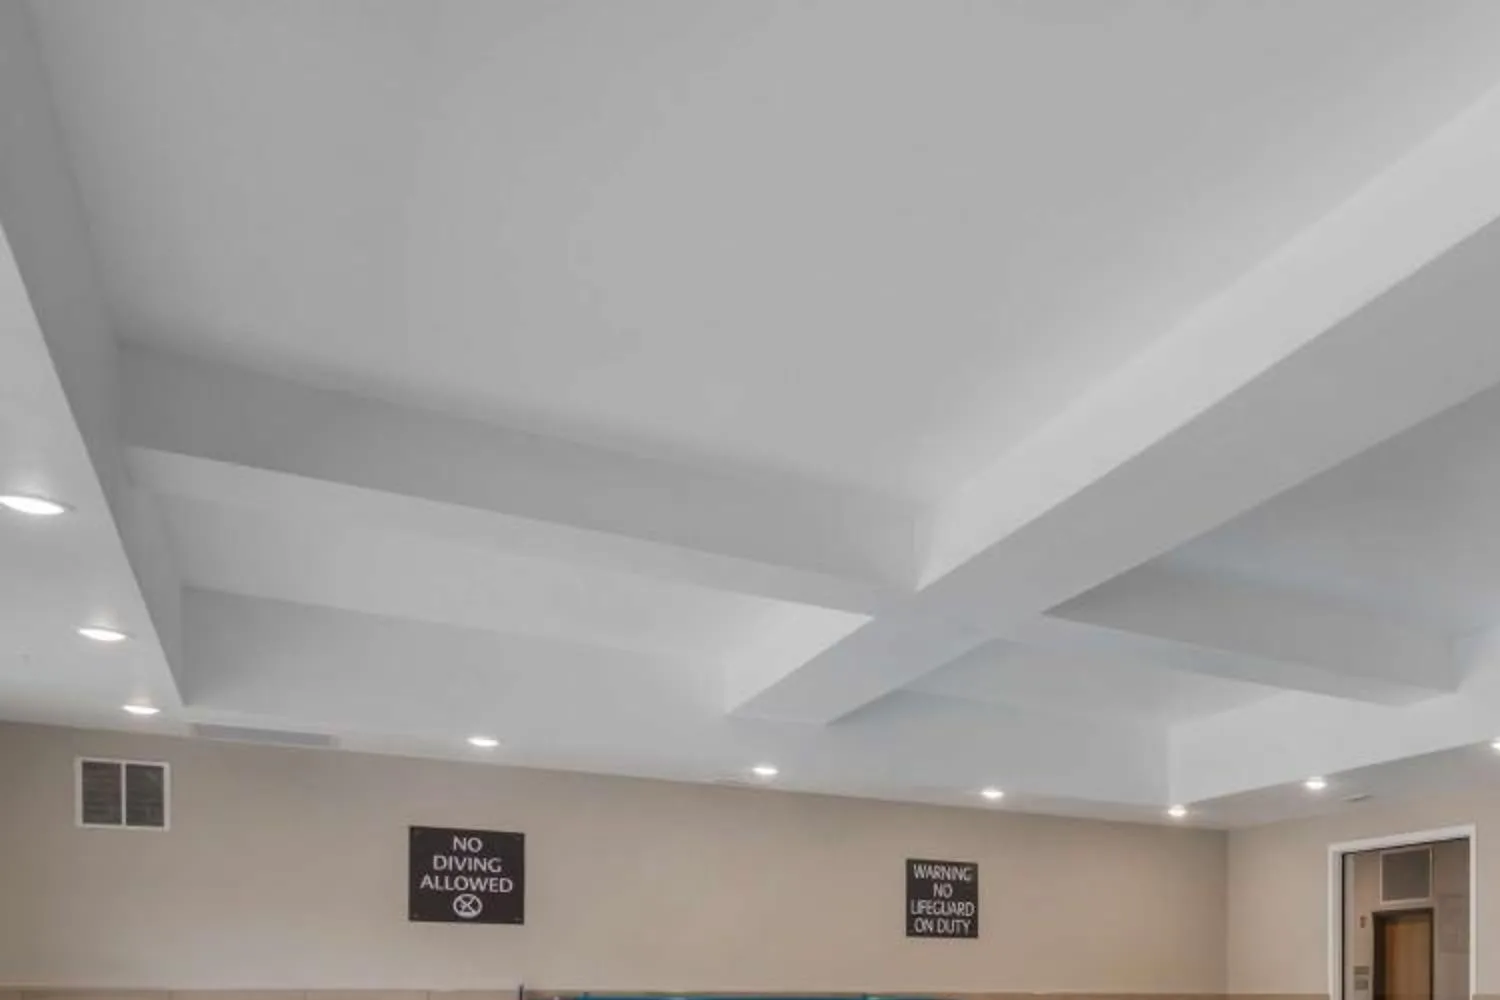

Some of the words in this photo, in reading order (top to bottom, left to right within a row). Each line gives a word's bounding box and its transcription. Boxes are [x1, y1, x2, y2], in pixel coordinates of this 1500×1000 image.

[452, 835, 483, 853] NO
[432, 854, 502, 873] DIVING
[913, 863, 973, 882] WARNING
[420, 874, 514, 893] ALLOWED
[932, 882, 953, 898] NO
[910, 899, 975, 917] LIFEGUARD
[914, 917, 934, 933] ON
[937, 918, 972, 935] DUTY
